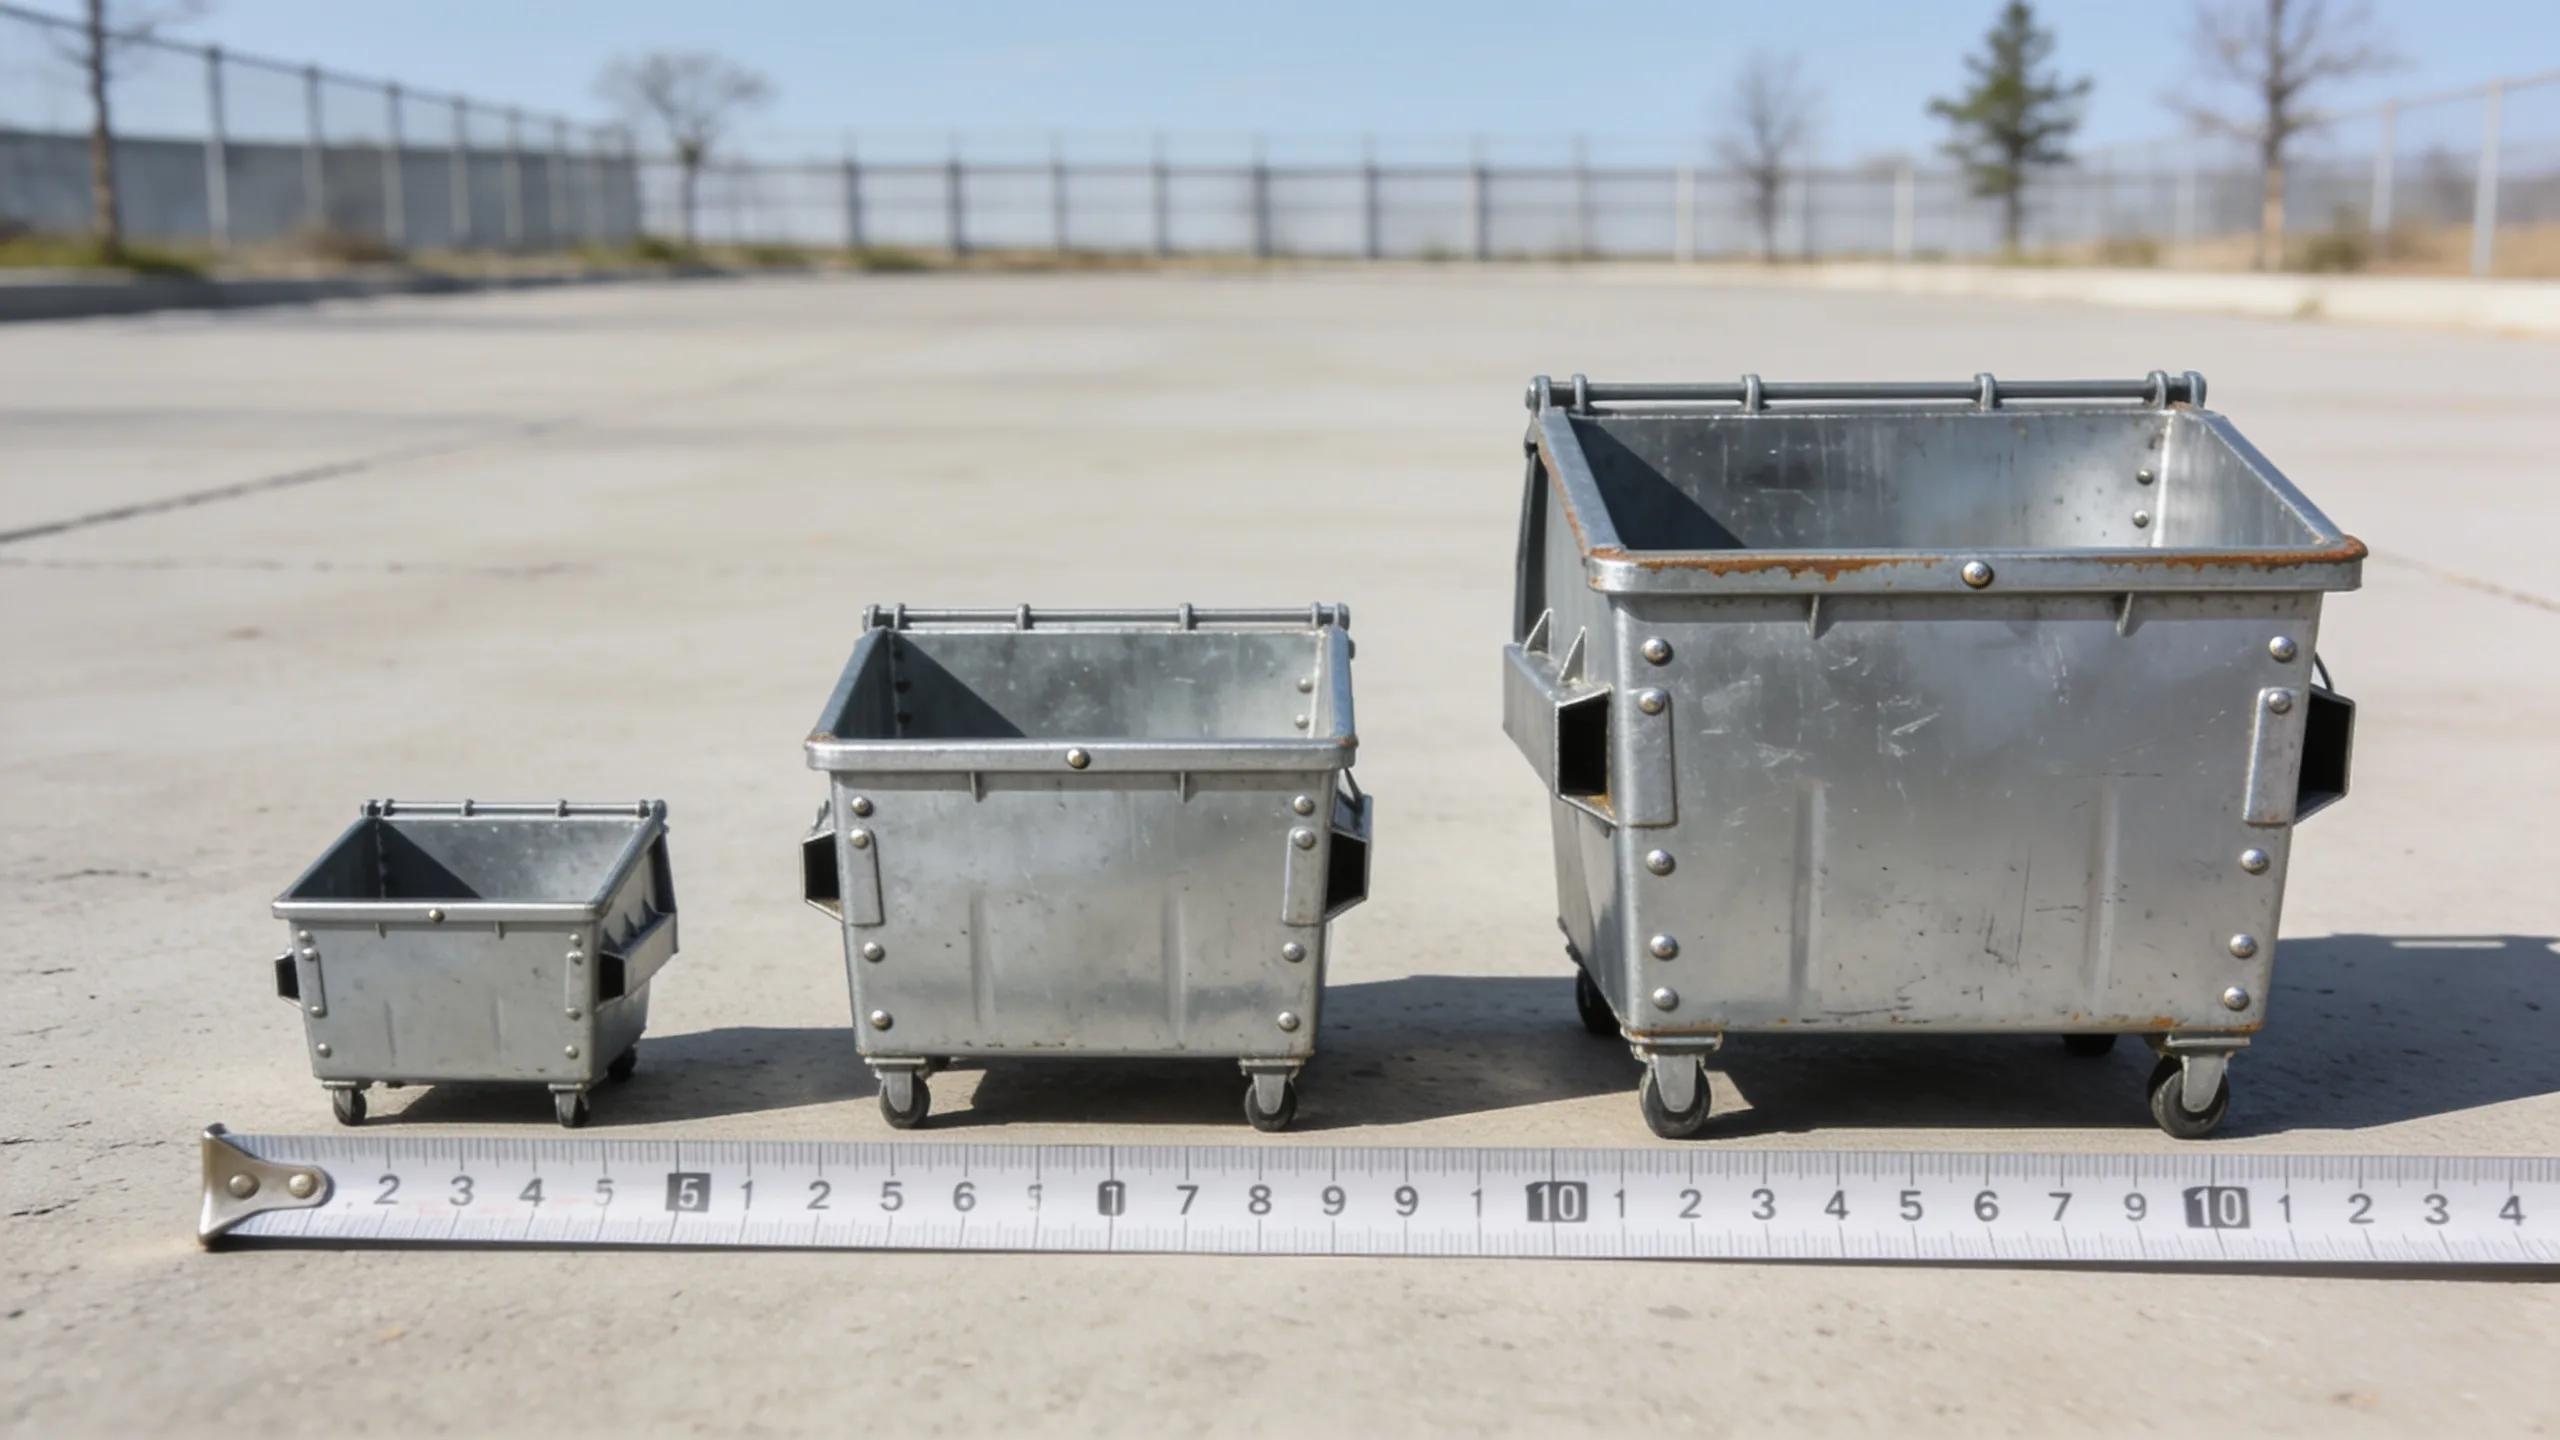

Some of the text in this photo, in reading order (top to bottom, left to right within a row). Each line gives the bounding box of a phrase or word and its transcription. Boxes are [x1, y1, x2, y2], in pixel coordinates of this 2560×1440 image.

[374, 1174, 401, 1205] 2
[450, 1175, 475, 1206] 3
[518, 1177, 546, 1207] 4
[678, 1178, 700, 1209] 5
[740, 1180, 753, 1210] 1
[806, 1180, 832, 1210] 2
[880, 1181, 904, 1212] 5
[952, 1181, 976, 1212] 6
[1176, 1184, 1199, 1215] 7
[1248, 1184, 1272, 1216] 8
[1321, 1185, 1346, 1216] 9
[1394, 1185, 1419, 1217] 9
[1471, 1188, 1482, 1218] 1
[1536, 1184, 1580, 1221] 10
[1613, 1188, 1625, 1219] 1
[1679, 1188, 1702, 1219] 2
[1751, 1188, 1776, 1220] 3
[1824, 1190, 1850, 1221] 4
[1900, 1190, 1924, 1221] 5
[1973, 1190, 1999, 1223] 6
[2048, 1192, 2073, 1221] 7
[2123, 1192, 2147, 1222] 9
[2193, 1188, 2242, 1227] 10
[2278, 1194, 2291, 1224] 1
[2348, 1193, 2374, 1224] 2
[2424, 1193, 2450, 1225] 3
[2498, 1195, 2526, 1226] 4
